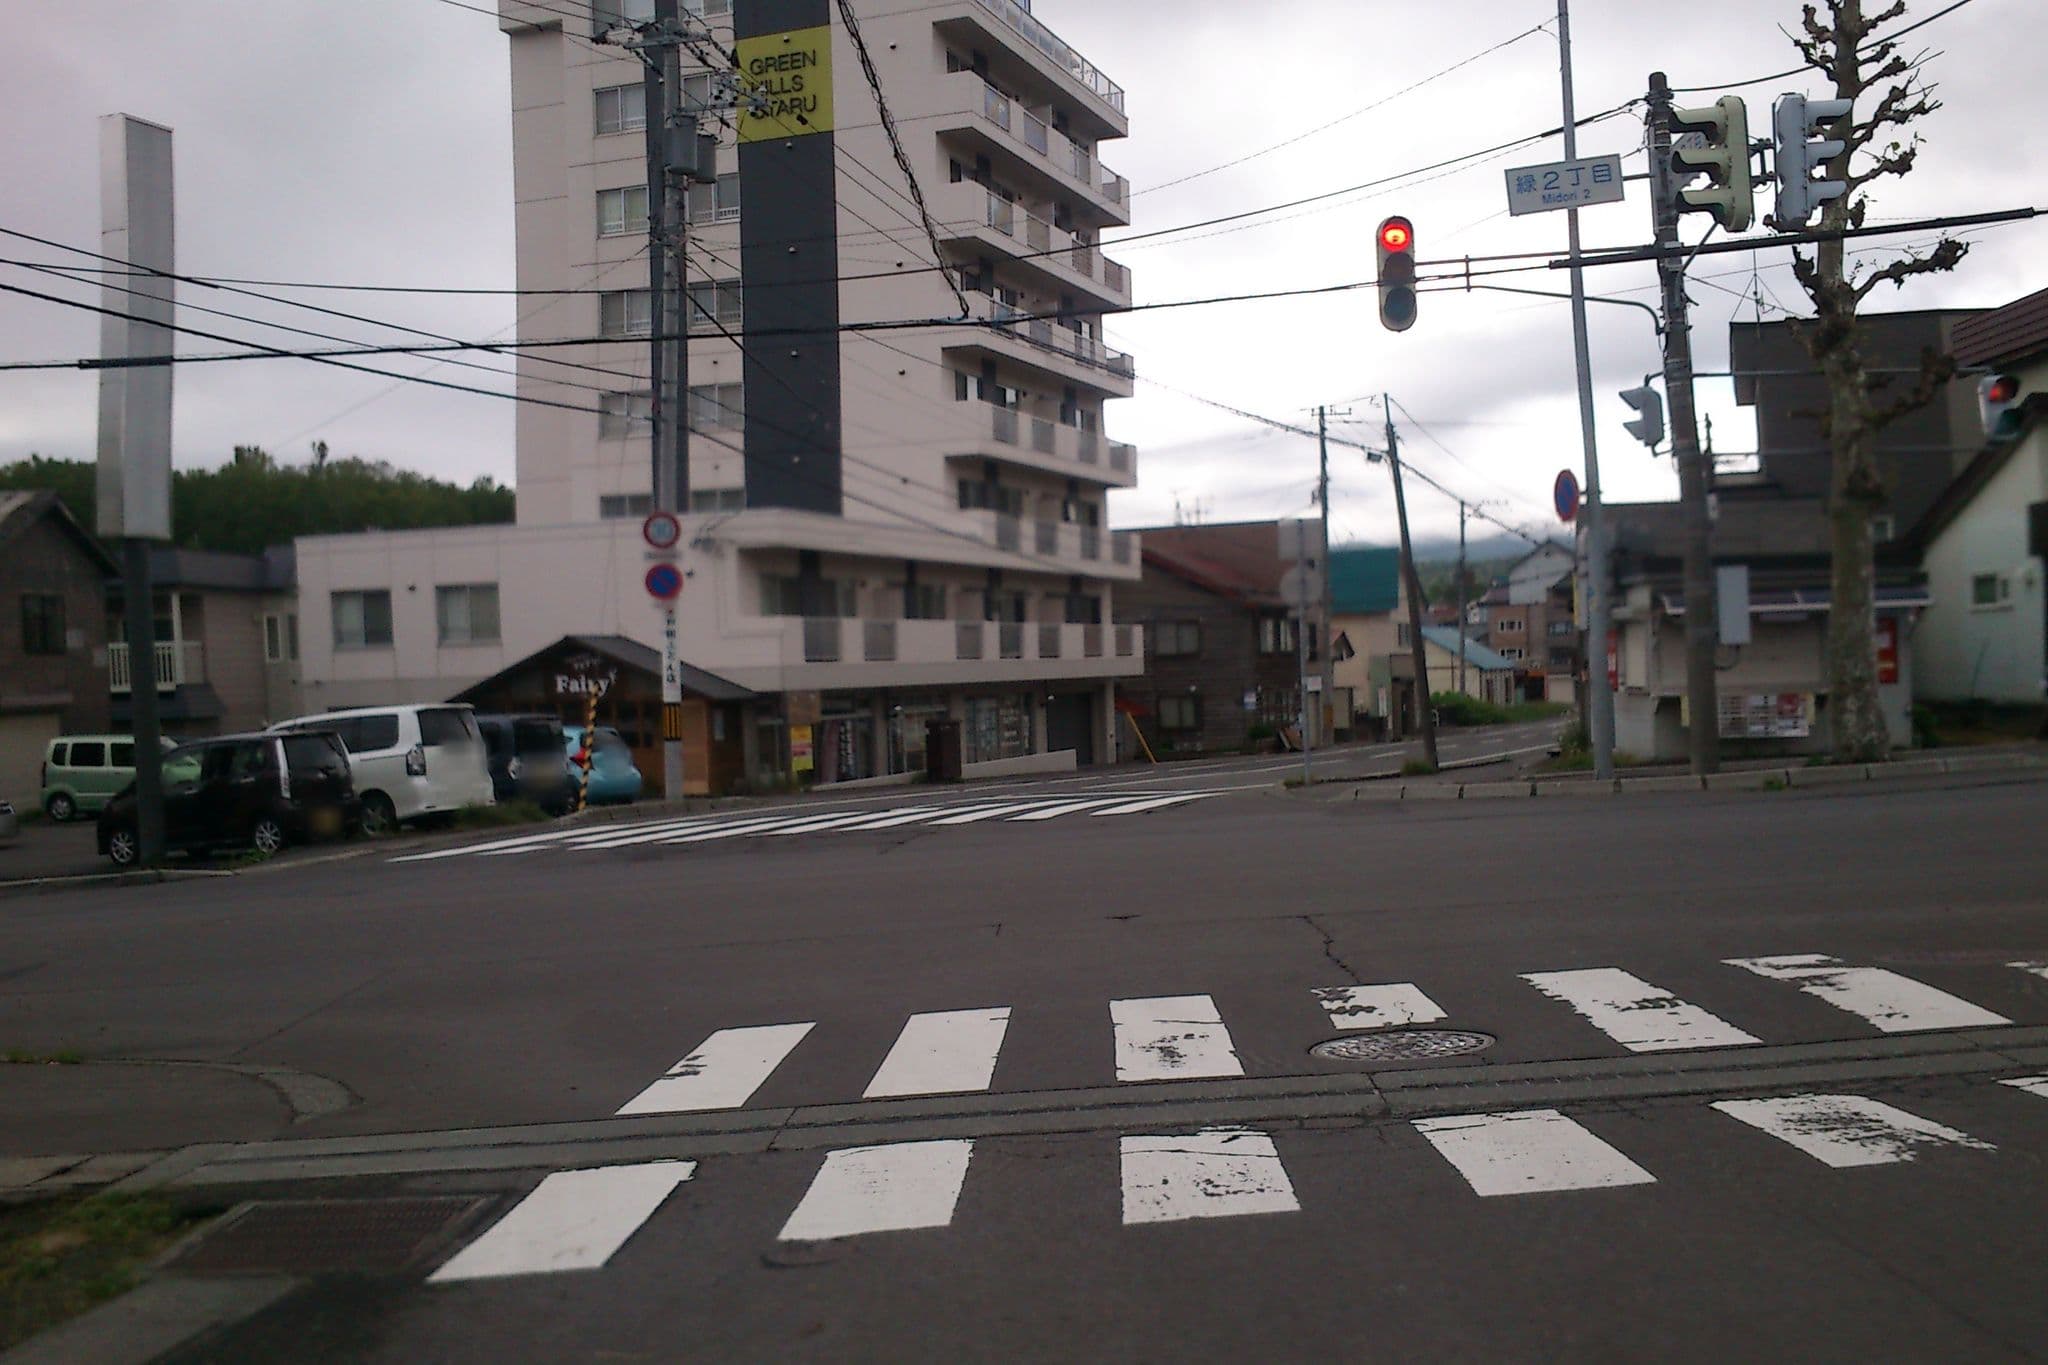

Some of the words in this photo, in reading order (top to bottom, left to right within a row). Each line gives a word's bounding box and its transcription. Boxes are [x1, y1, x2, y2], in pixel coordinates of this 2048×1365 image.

[750, 48, 816, 75] GREEN
[1516, 163, 1612, 194] 緑2丁目
[1542, 192, 1577, 205] Midori
[1583, 188, 1591, 199] 2
